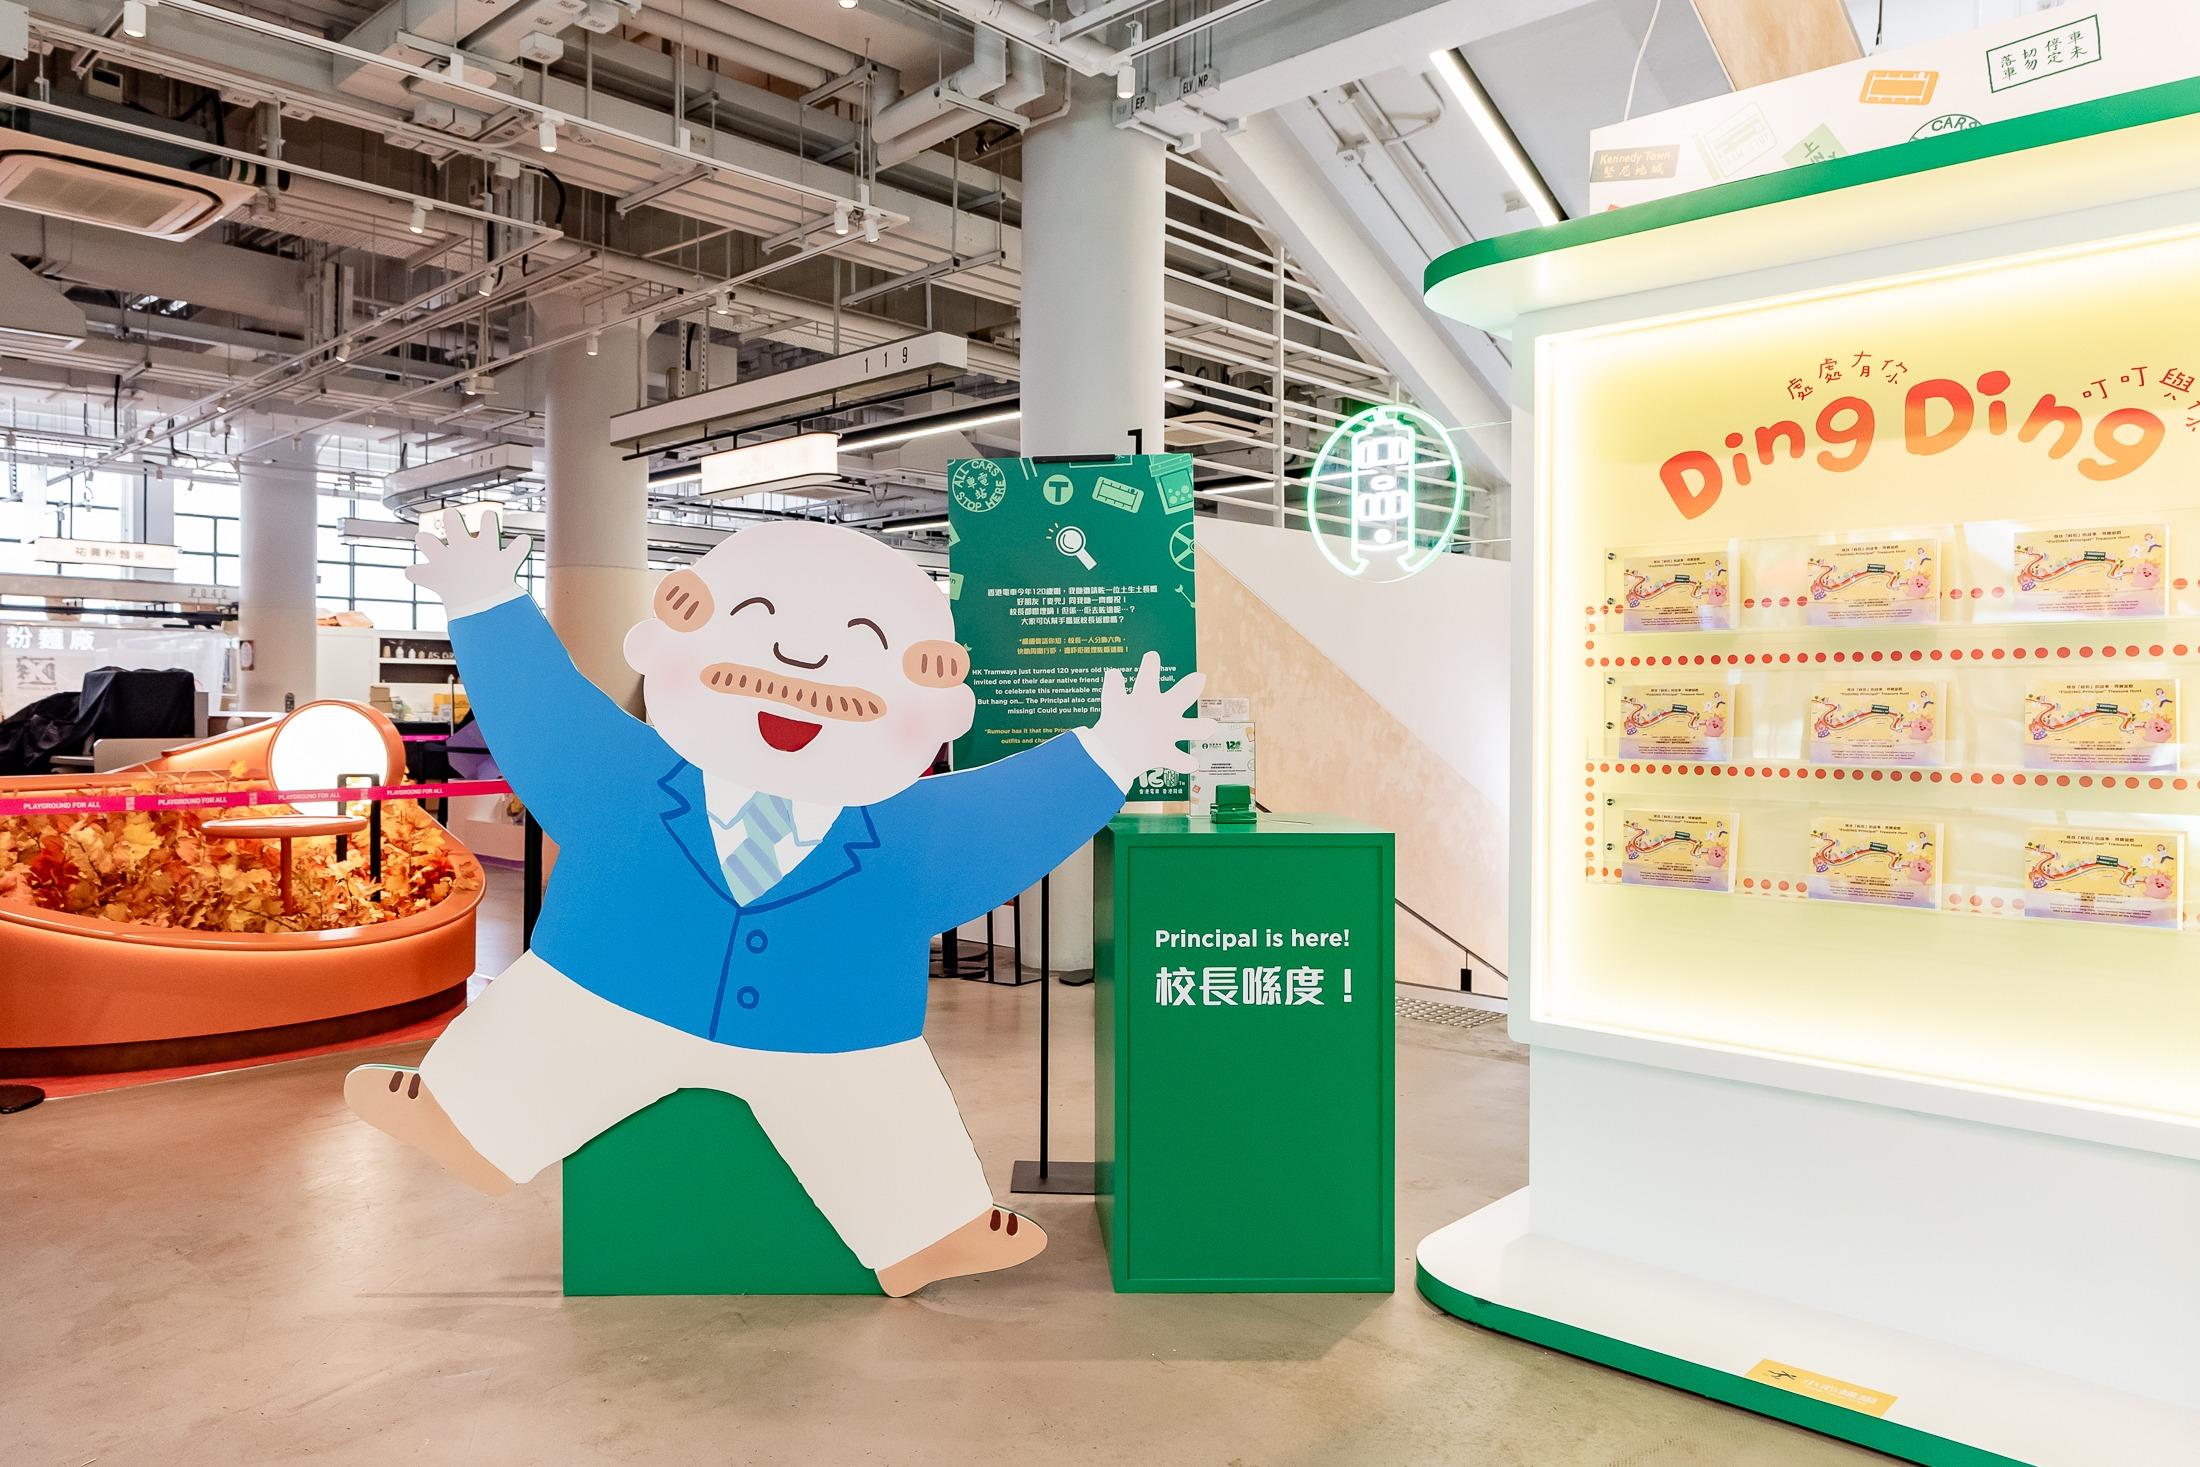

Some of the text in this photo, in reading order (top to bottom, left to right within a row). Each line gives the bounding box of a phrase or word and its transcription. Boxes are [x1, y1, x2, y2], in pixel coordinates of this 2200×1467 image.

[1183, 81, 1194, 94] ELV
[1198, 74, 1208, 87] NP
[1136, 96, 1145, 109] EP
[1600, 151, 1671, 165] Kennedy Town
[1659, 370, 2166, 519] Ding Ding
[971, 460, 1000, 477] CARS
[954, 469, 969, 488] ALL
[956, 480, 1004, 511] STOP HERE
[1156, 928, 1350, 951] Principal is here!
[1156, 966, 1352, 1006] 校長喺度！
